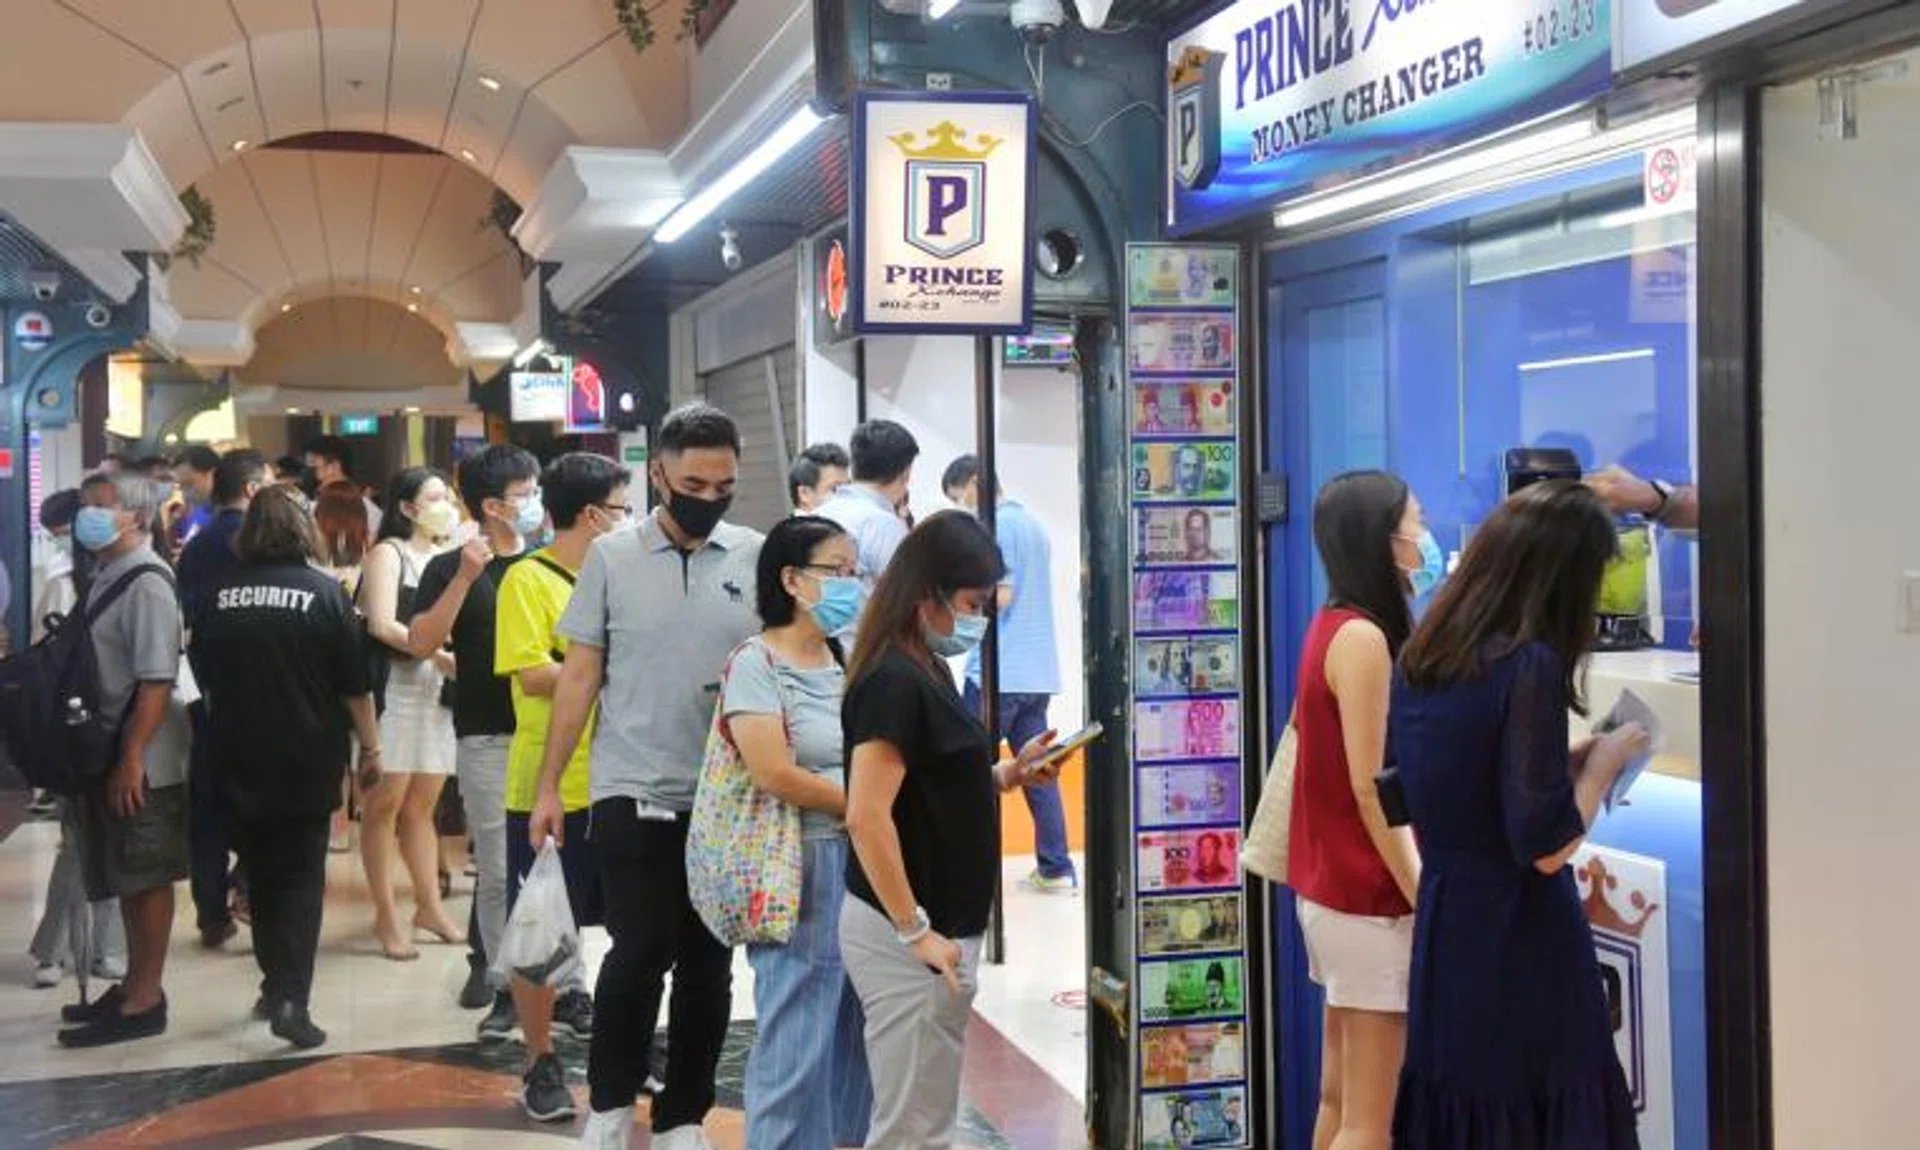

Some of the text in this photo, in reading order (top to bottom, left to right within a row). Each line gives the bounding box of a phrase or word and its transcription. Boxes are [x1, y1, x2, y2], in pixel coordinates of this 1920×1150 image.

[1235, 0, 1353, 110] PRINCE
[1252, 36, 1485, 162] MONEY CHANGER
[1180, 101, 1195, 165] P
[924, 175, 968, 236] P
[884, 264, 1003, 286] PRINCE
[217, 585, 316, 613] SECURITY
